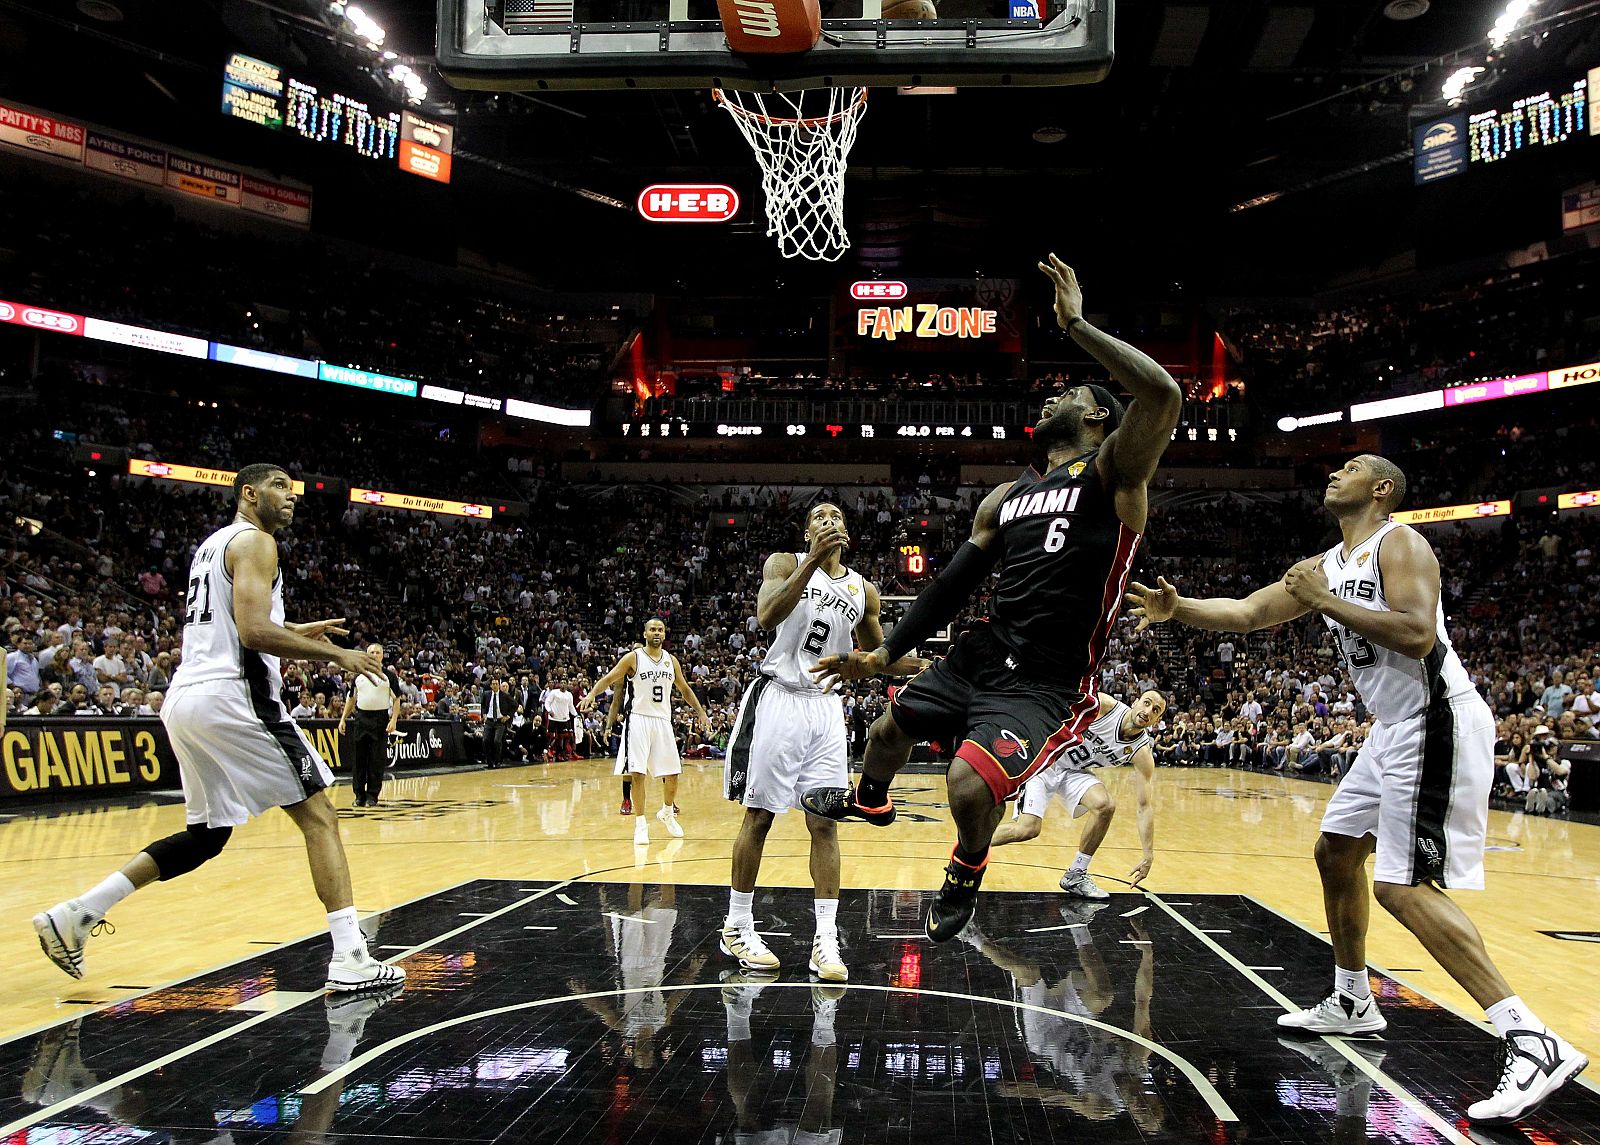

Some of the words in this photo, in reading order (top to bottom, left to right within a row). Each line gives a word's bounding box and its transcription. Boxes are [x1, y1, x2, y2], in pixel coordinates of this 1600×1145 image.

[1013, 6, 1035, 18] NBA
[0, 105, 51, 135] PATTY'S
[127, 146, 164, 163] FORCE
[858, 306, 913, 340] FAN
[916, 304, 997, 338] ZONE
[1563, 368, 1600, 382] HO
[935, 427, 955, 436] PER
[961, 426, 973, 437] 4
[402, 497, 414, 506] Do
[423, 499, 444, 511] Right
[999, 487, 1082, 526] MIAMI
[1412, 512, 1423, 520] Do
[1433, 509, 1455, 519] Right
[1044, 517, 1070, 553] 6
[908, 555, 924, 573] 10
[184, 569, 215, 626] 21
[801, 617, 832, 658] 2
[640, 671, 673, 681] SPURS
[652, 685, 663, 703] 9
[3, 730, 131, 792] GAME
[135, 730, 161, 782] 3
